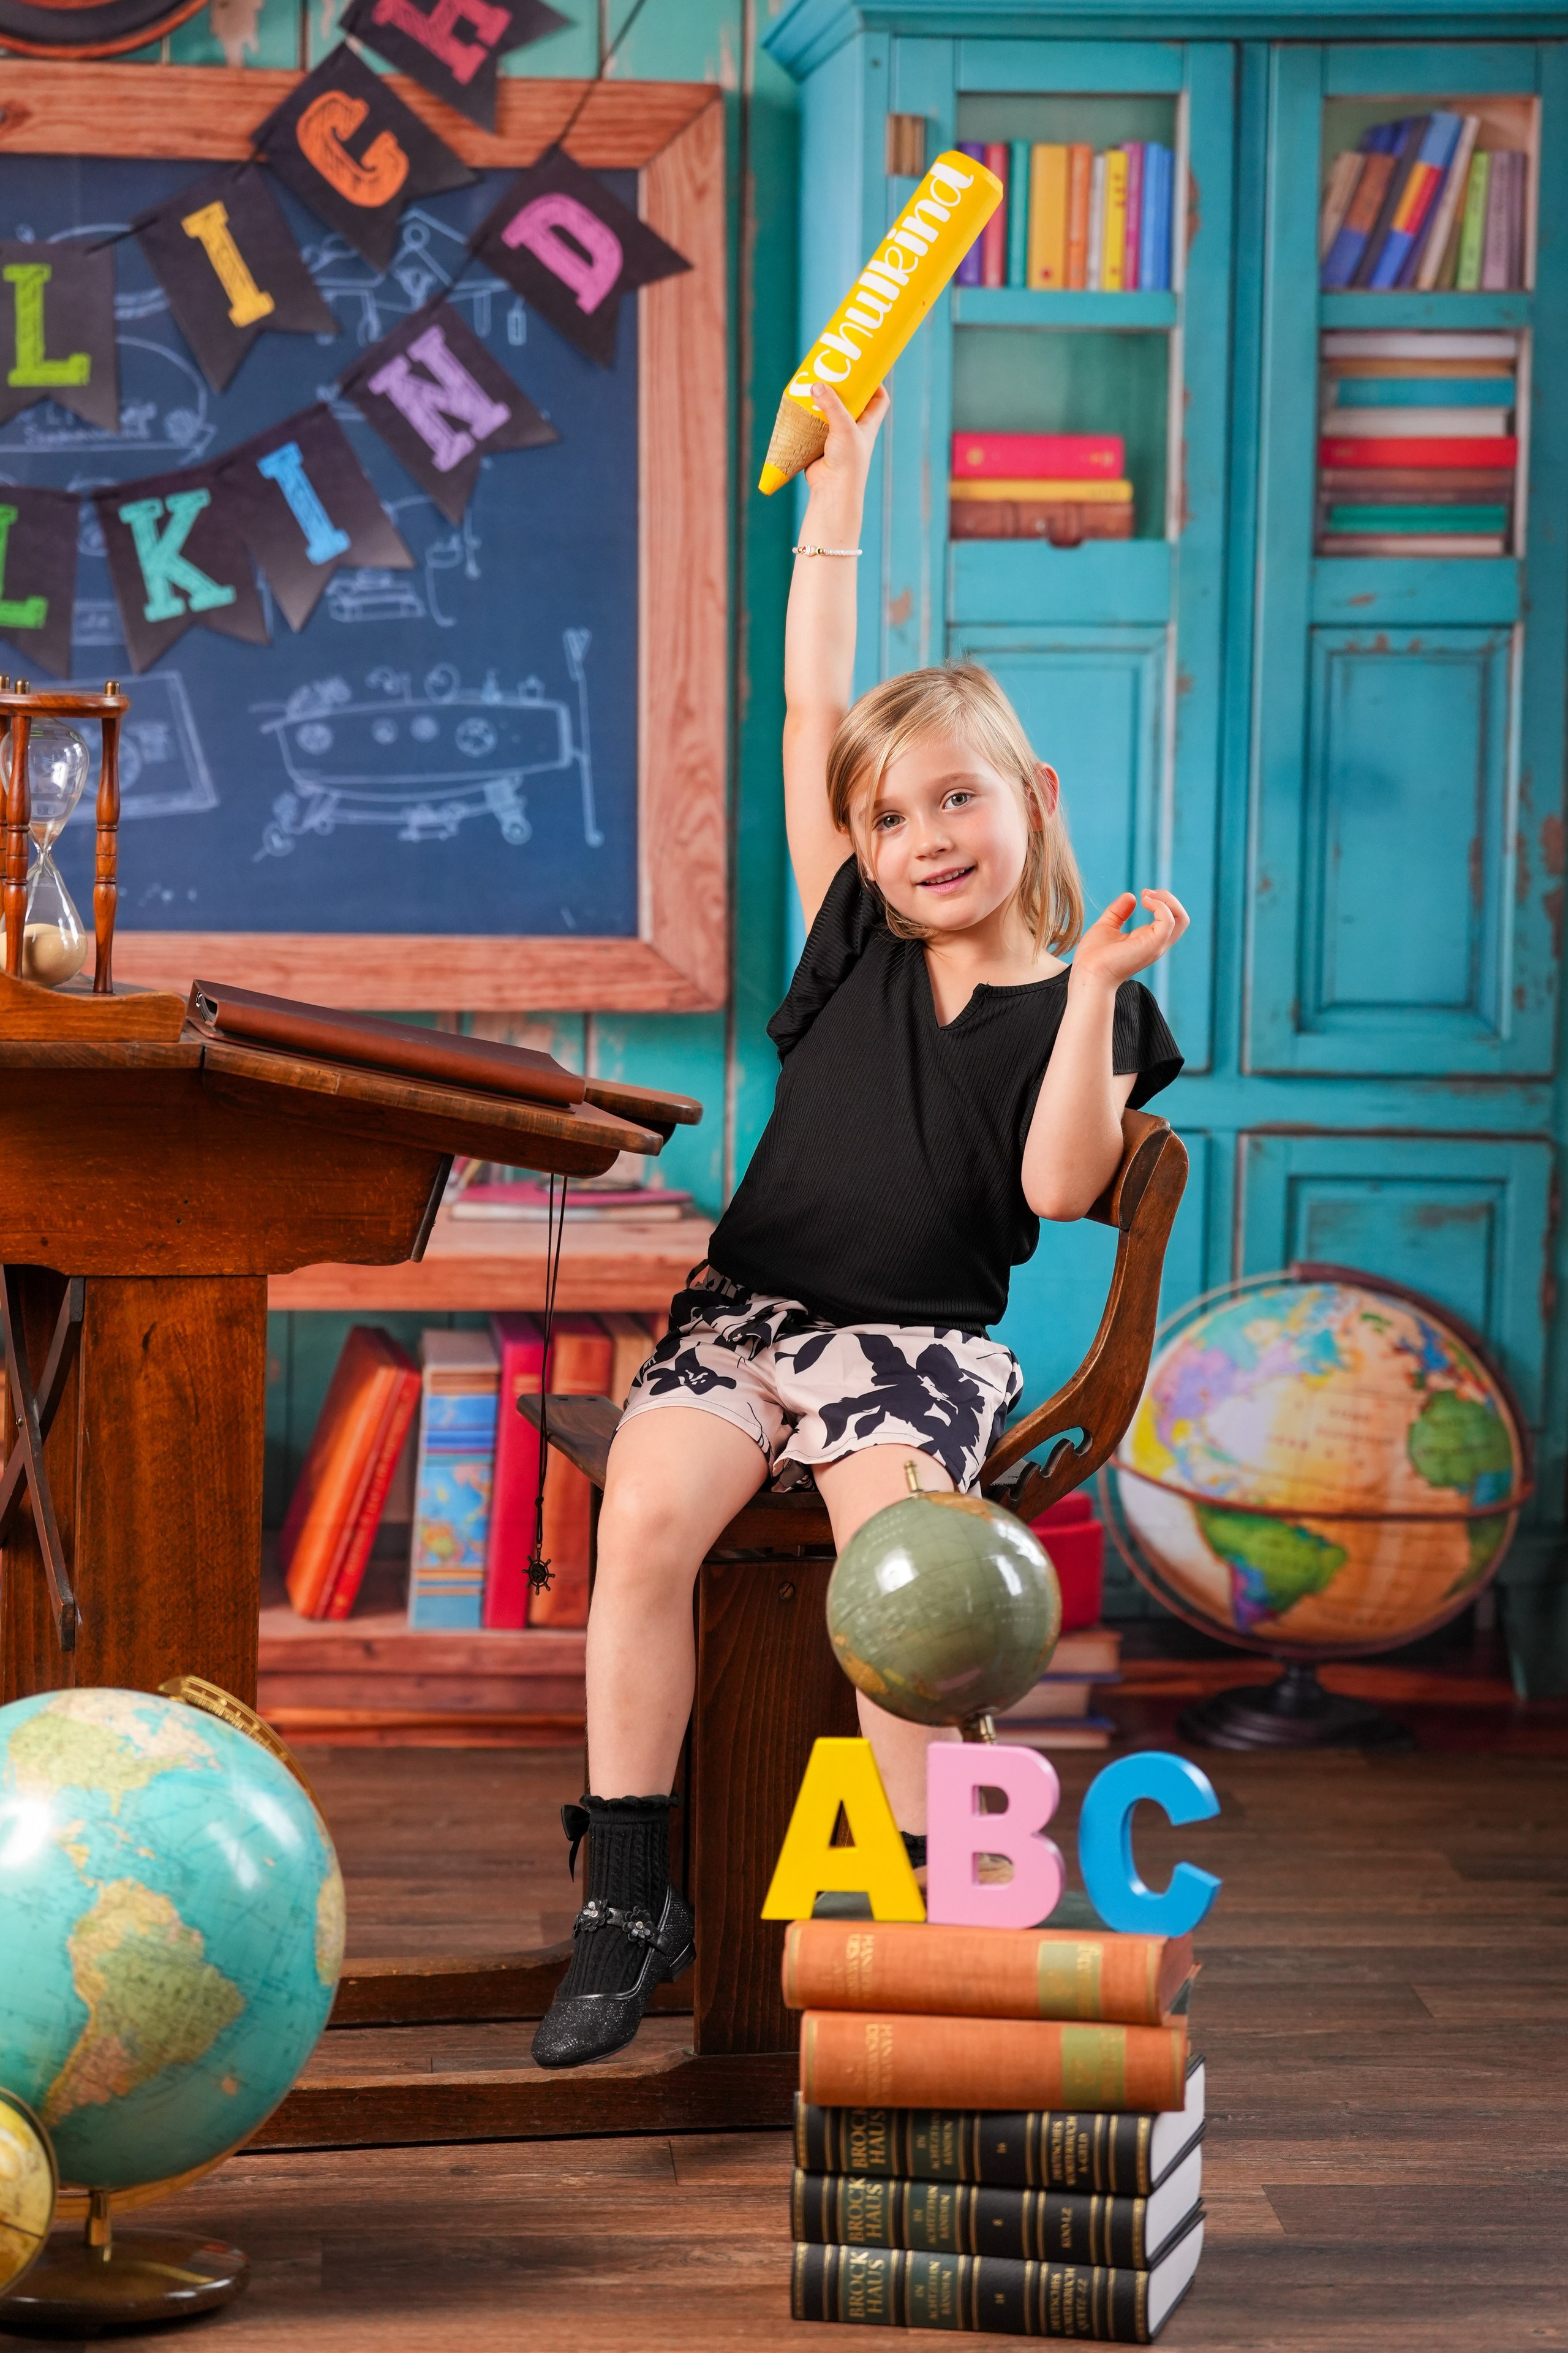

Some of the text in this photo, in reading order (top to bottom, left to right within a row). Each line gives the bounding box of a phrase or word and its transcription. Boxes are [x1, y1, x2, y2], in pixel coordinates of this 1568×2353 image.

[868, 2110, 886, 2164] HAUS
[846, 2177, 867, 2243] BROCK
[865, 2183, 883, 2238] HAUS
[847, 2251, 869, 2317] BROCK
[867, 2258, 885, 2314] HAUS
